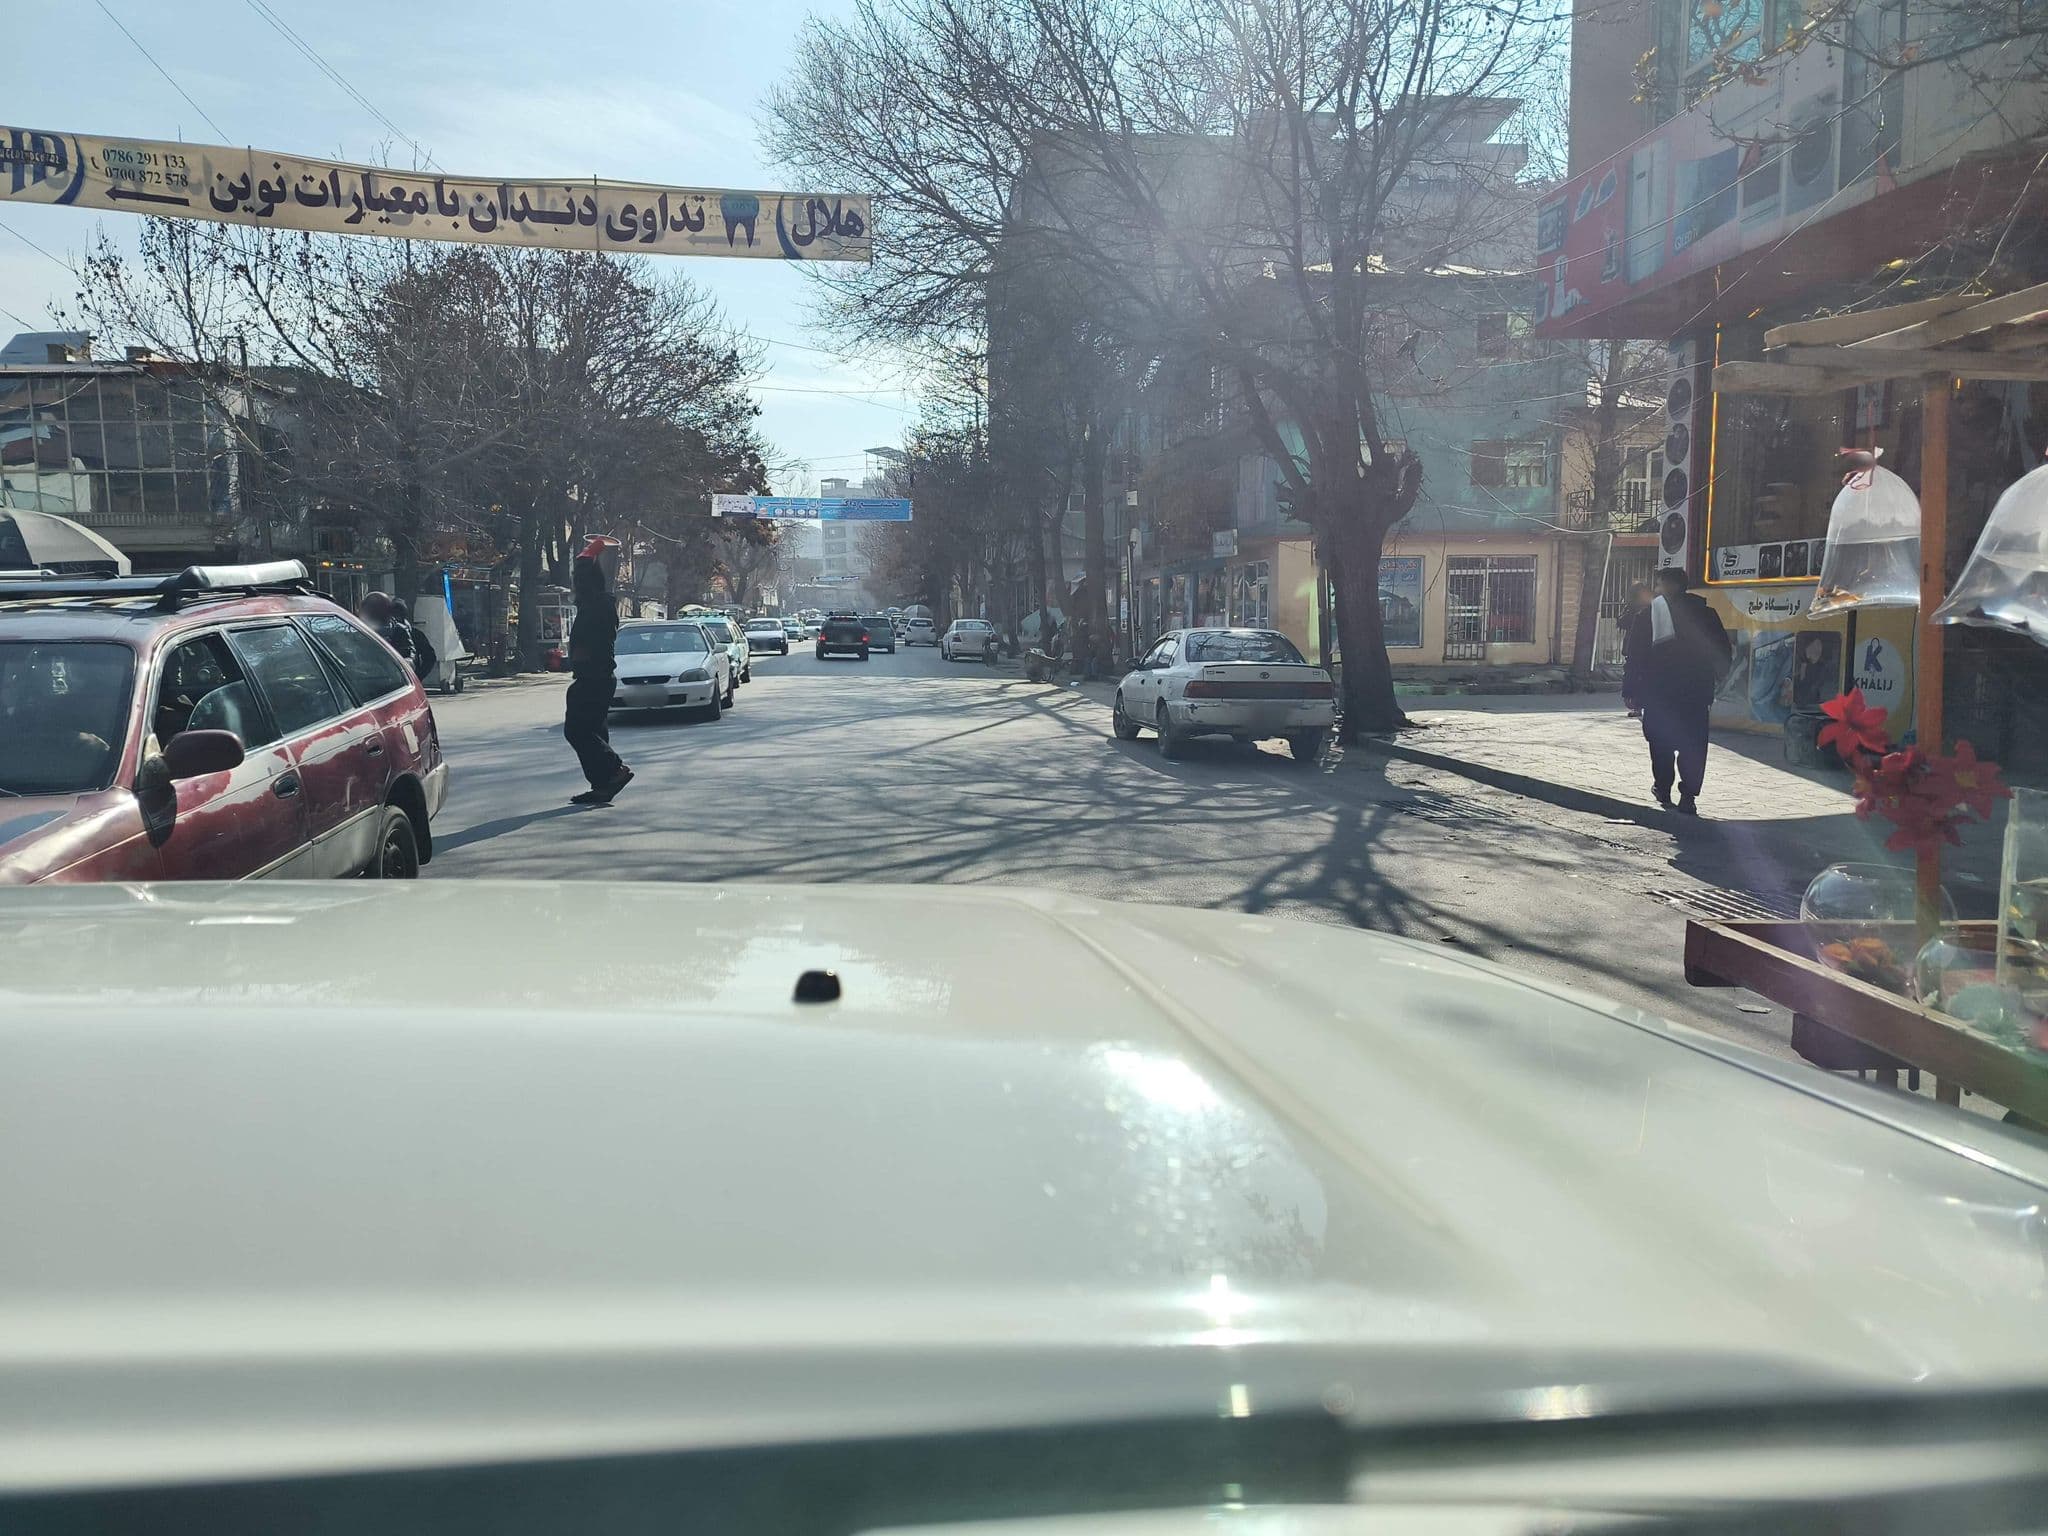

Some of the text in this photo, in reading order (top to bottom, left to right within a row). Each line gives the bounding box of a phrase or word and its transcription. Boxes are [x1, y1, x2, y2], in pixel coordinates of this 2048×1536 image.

[103, 148, 186, 169] 0786 291 133
[105, 166, 189, 187] 0700 872 578
[208, 161, 706, 244] تداوی دندان با معیارات نوین
[791, 199, 865, 247] هلال
[1765, 597, 1801, 616] فروشگاه
